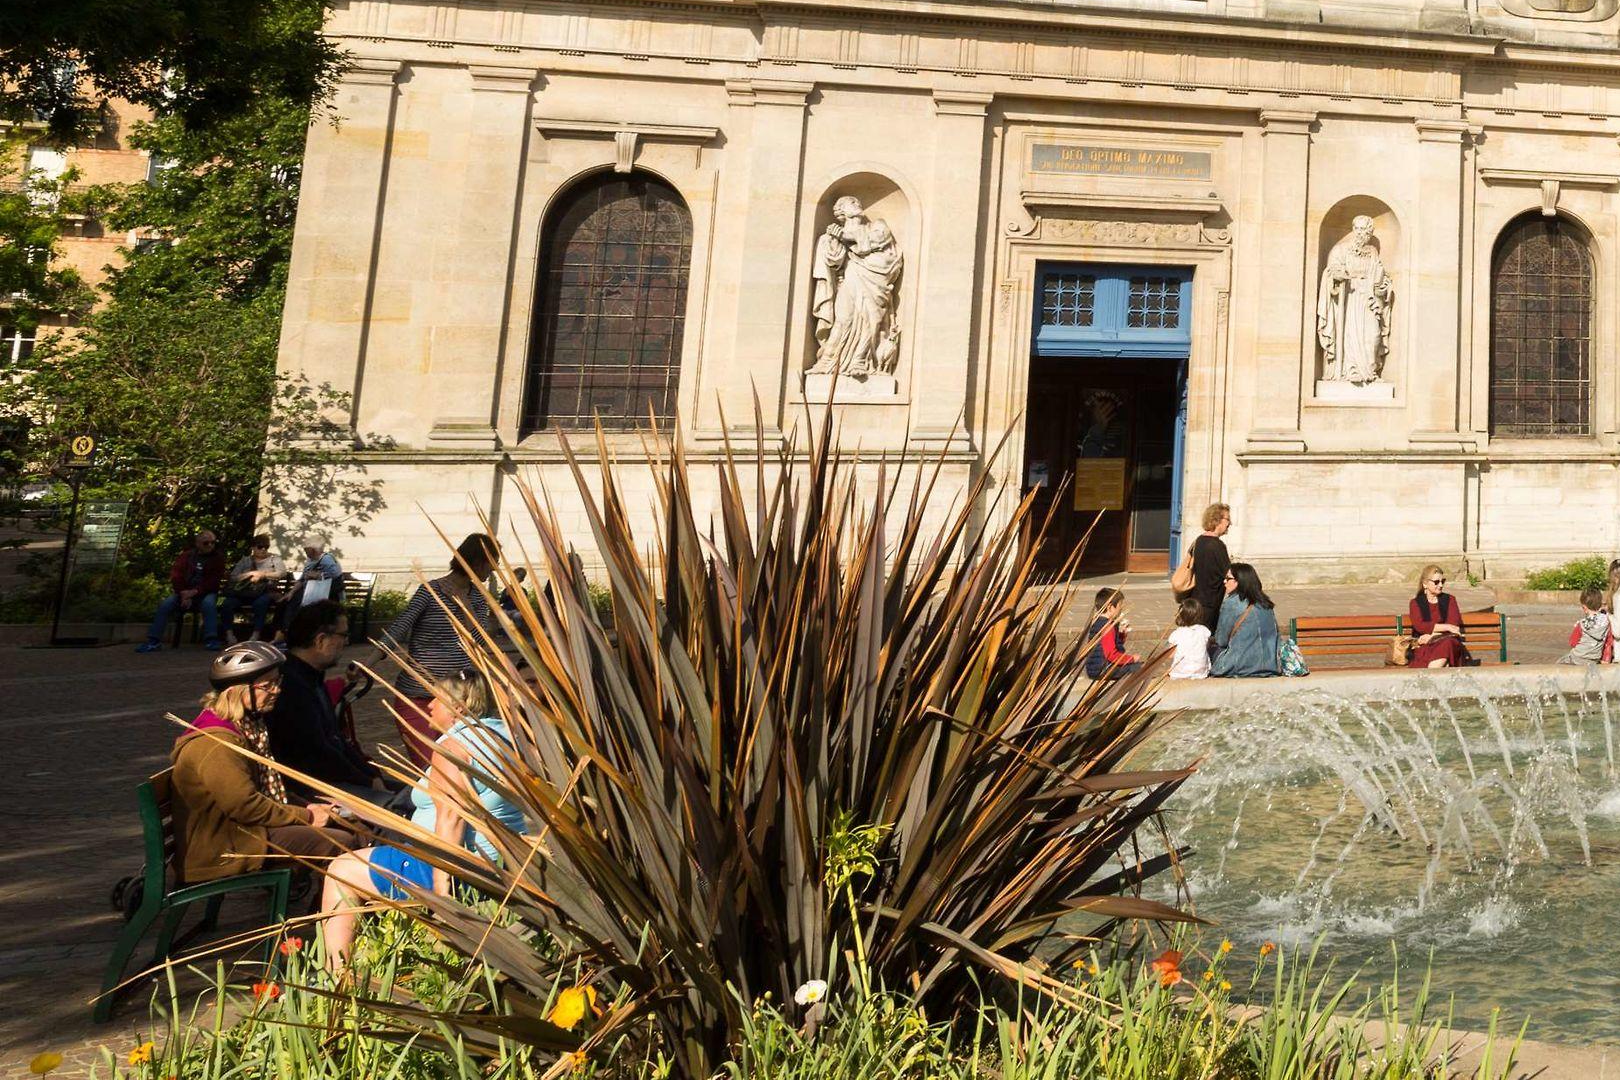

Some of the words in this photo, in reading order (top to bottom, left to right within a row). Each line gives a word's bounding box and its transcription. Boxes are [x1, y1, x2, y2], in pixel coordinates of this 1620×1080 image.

[1061, 149, 1083, 161] DEO
[1090, 150, 1131, 163] OPTIMO
[1138, 151, 1185, 165] MAXIMO
